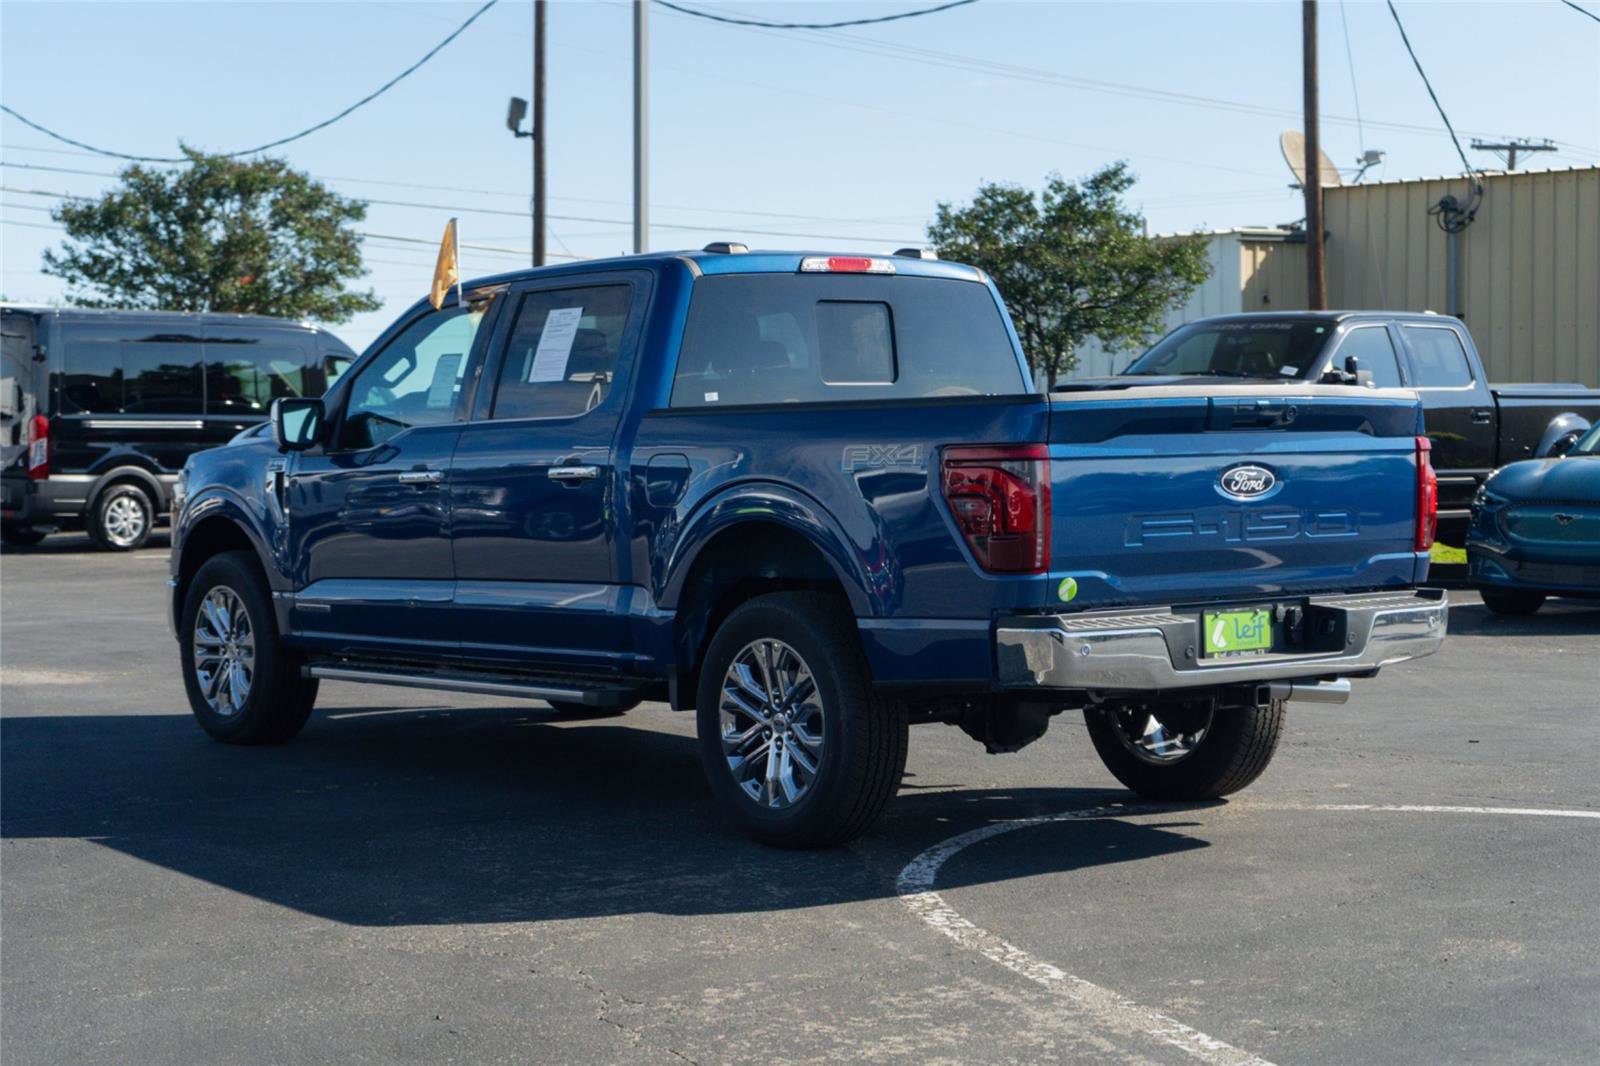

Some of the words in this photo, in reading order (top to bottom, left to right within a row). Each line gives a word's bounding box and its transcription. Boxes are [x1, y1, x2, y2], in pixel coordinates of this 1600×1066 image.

[841, 444, 923, 473] FX4
[1231, 471, 1266, 492] Ford
[1124, 509, 1359, 547] F-150
